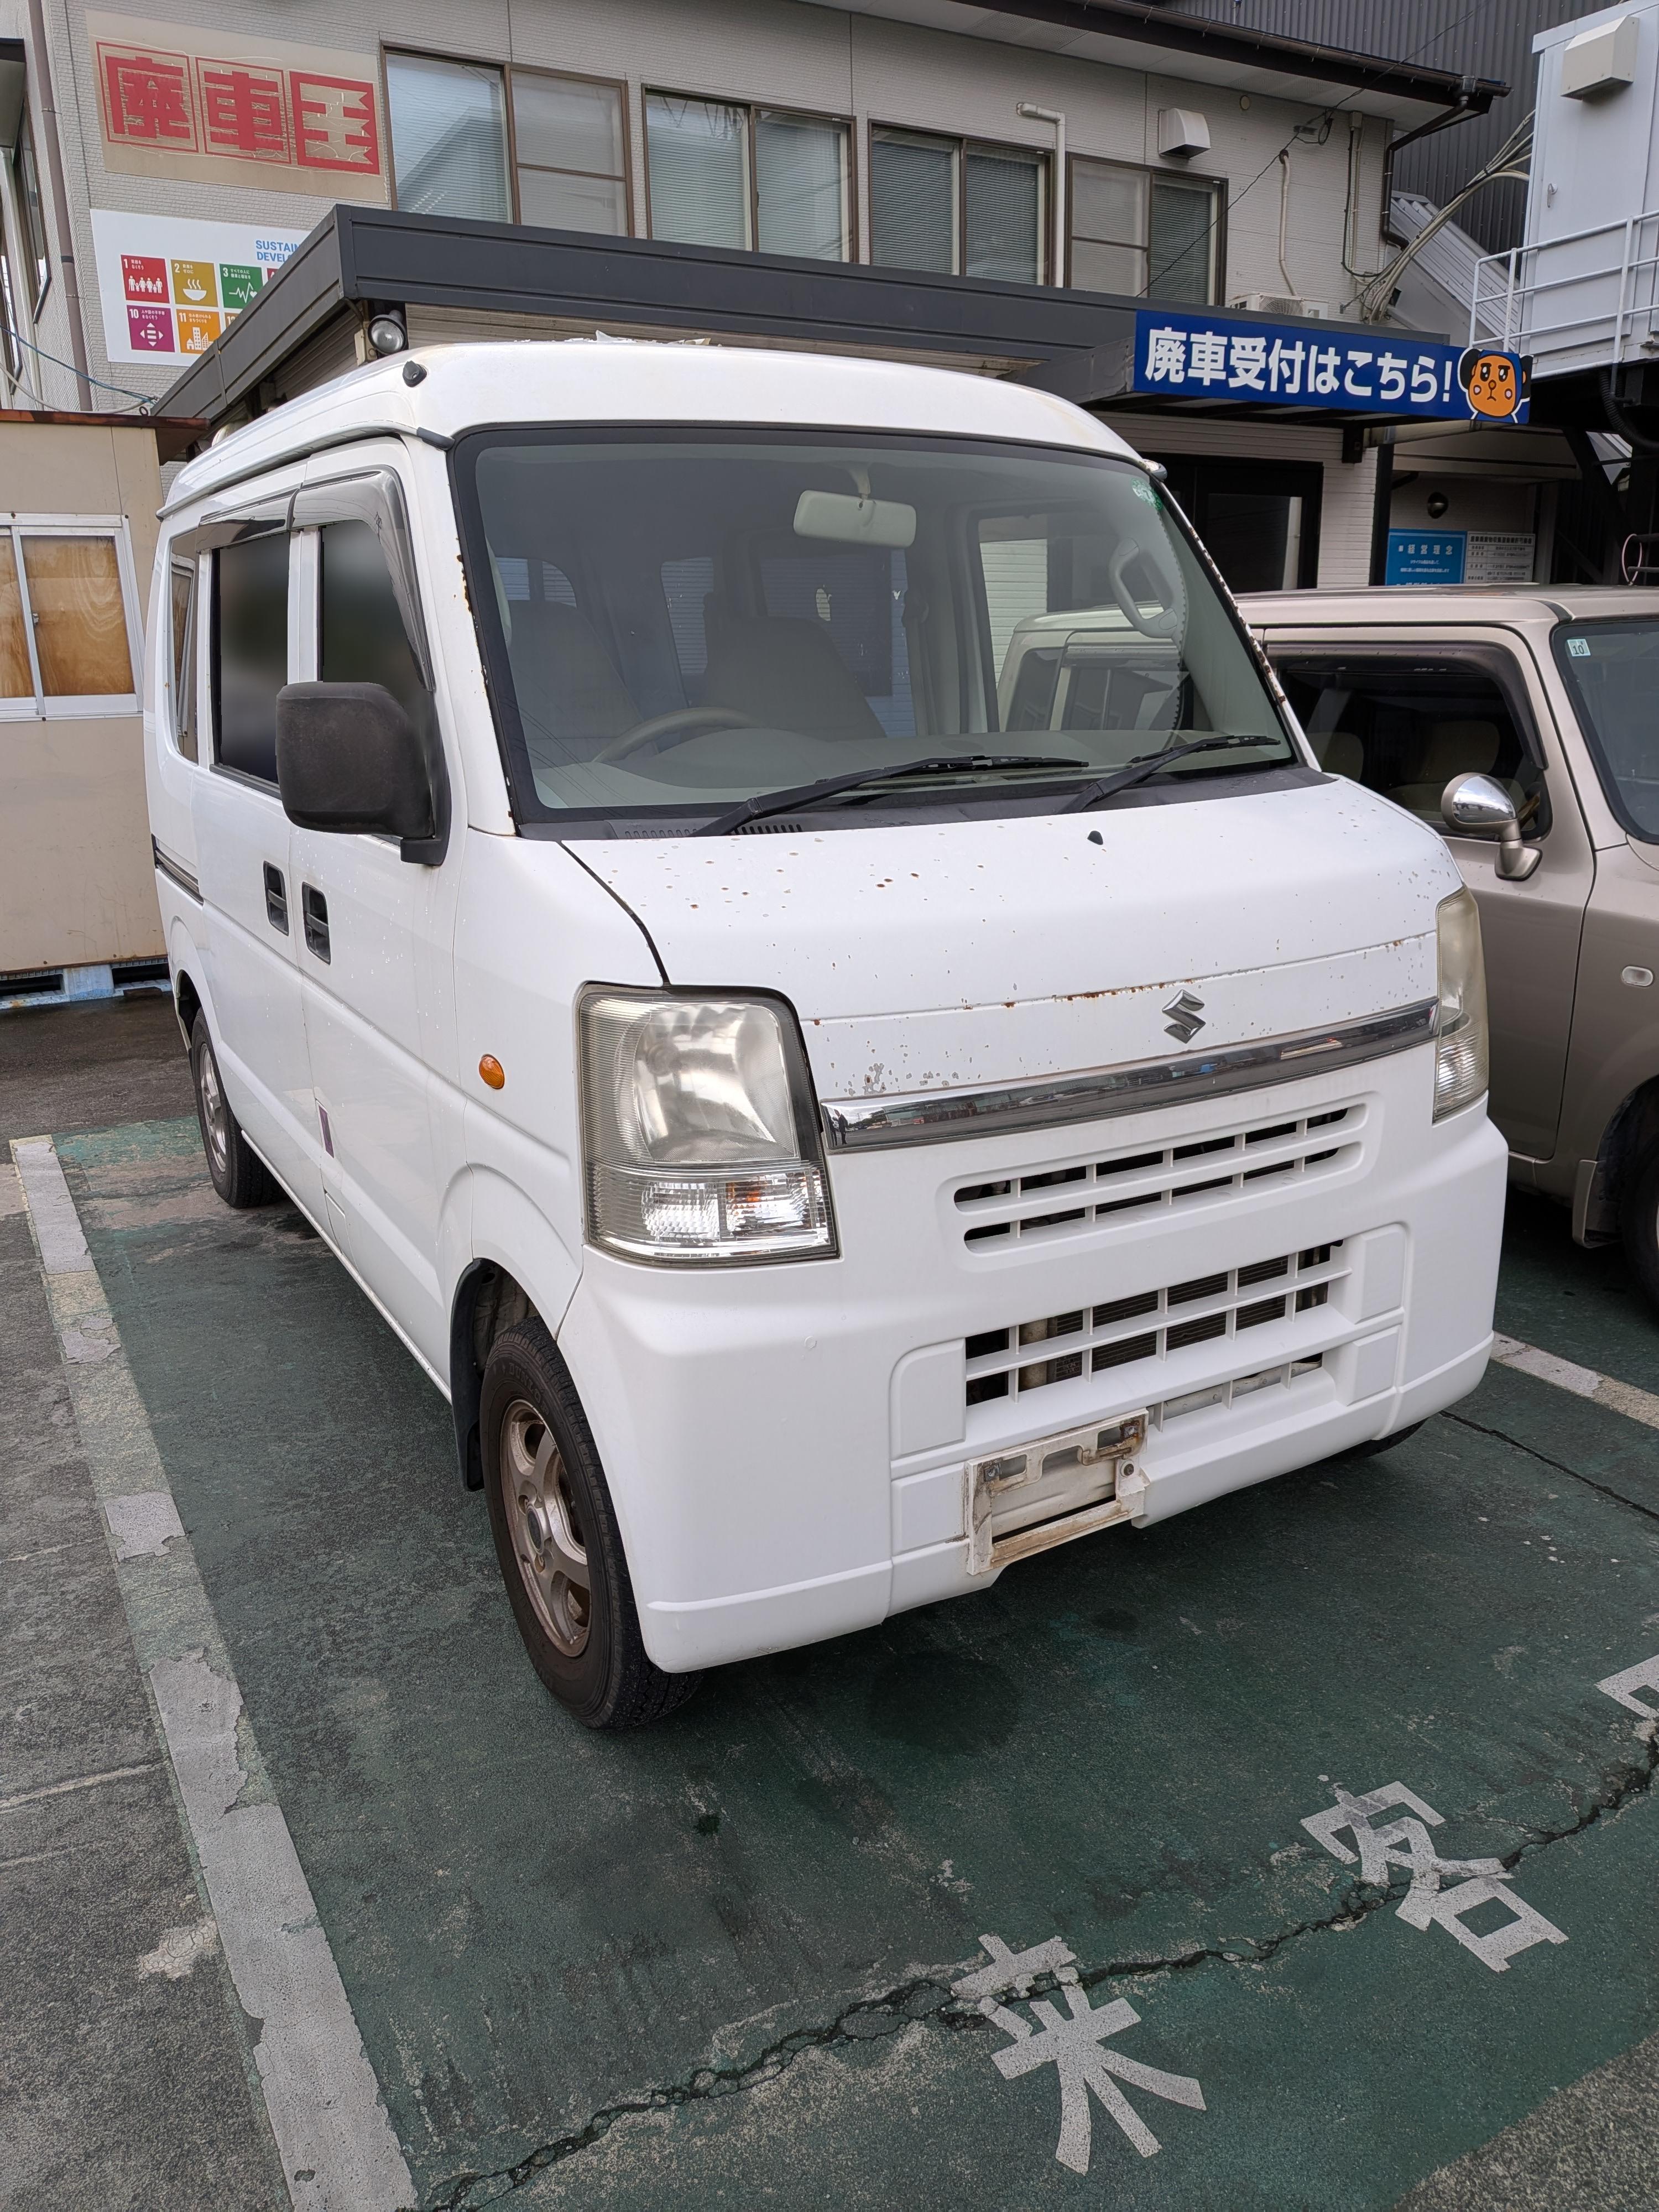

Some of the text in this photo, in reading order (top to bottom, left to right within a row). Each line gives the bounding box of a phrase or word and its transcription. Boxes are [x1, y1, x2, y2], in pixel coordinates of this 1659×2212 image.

[98, 43, 380, 175] 廃車王
[257, 251, 291, 262] DEVEL
[123, 258, 128, 269] 1
[174, 263, 180, 273] 2
[222, 267, 228, 277] 3
[129, 309, 139, 319] 10
[179, 312, 187, 322] 11
[1145, 327, 1453, 403] 廃車受付はこちら!
[1572, 644, 1584, 655] 10
